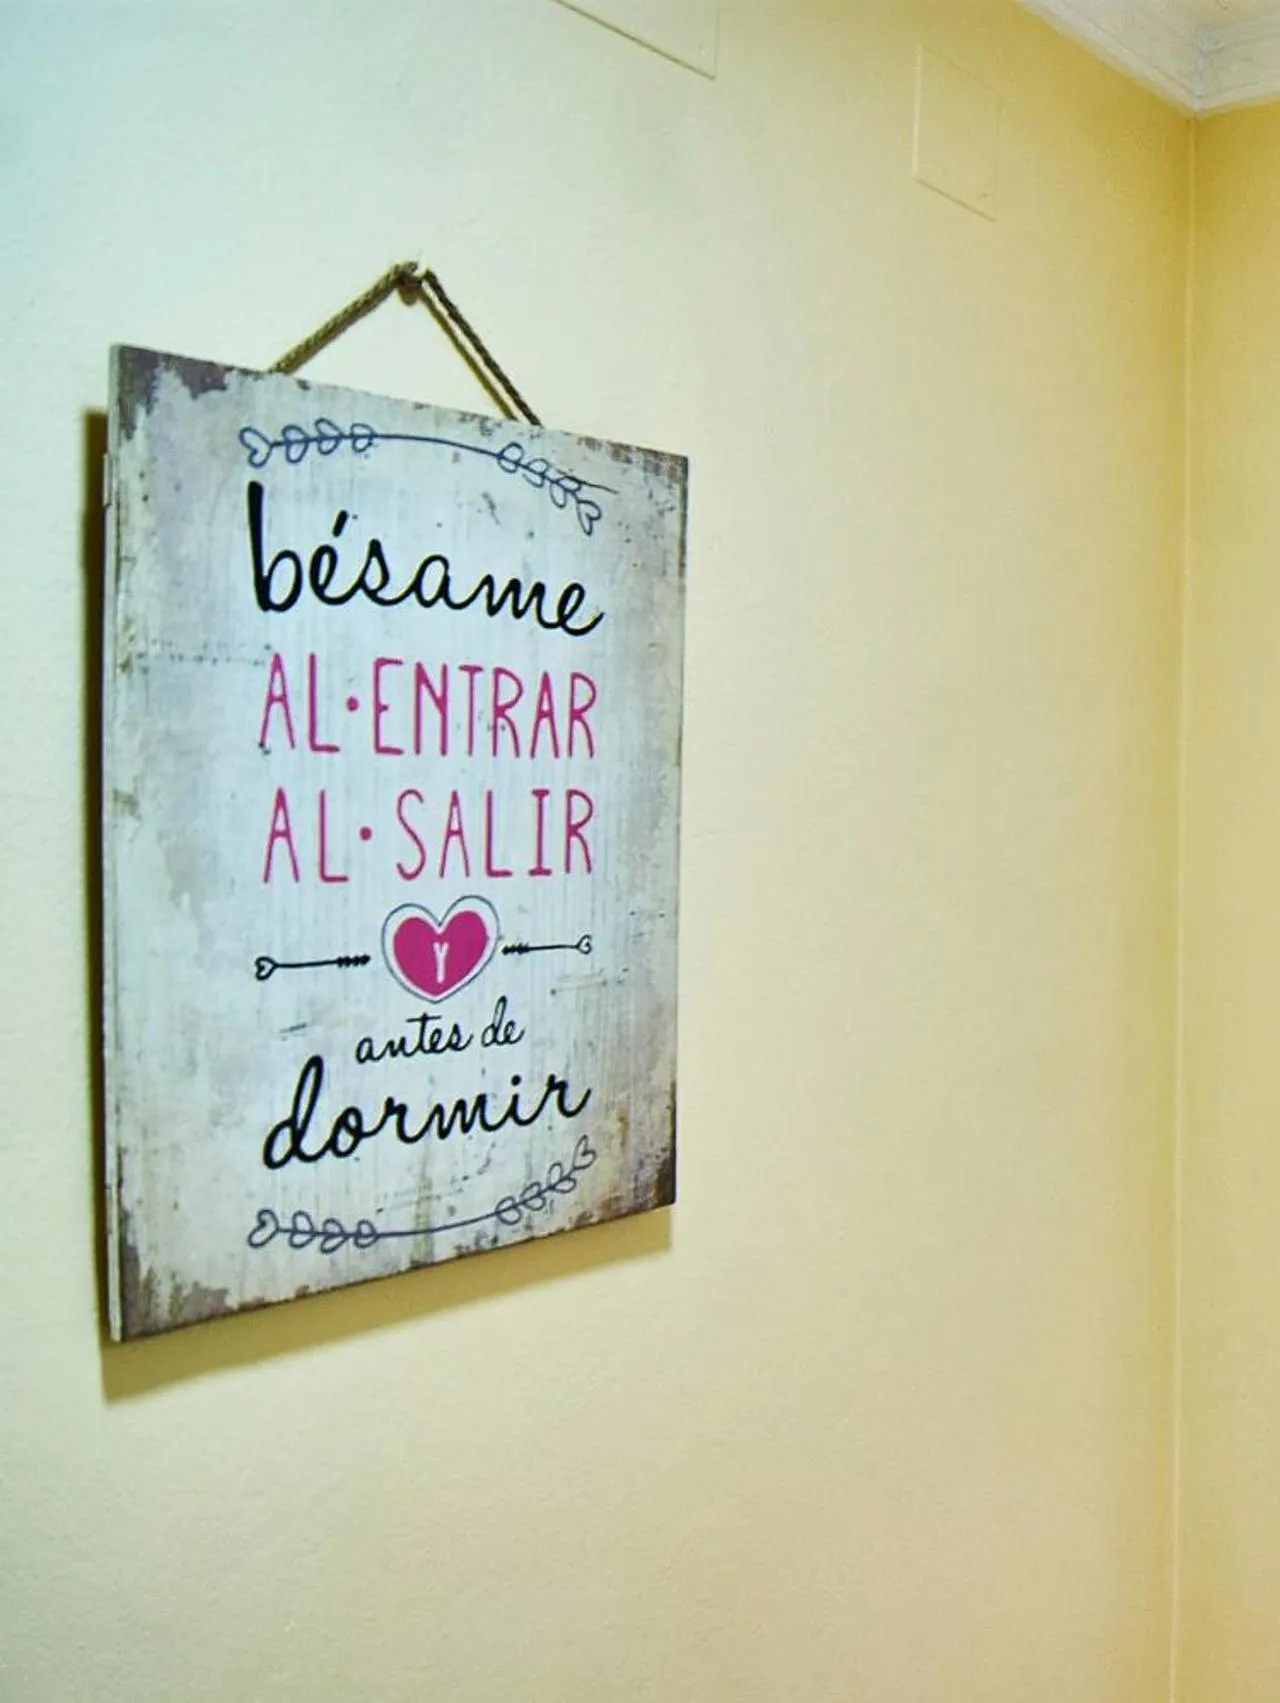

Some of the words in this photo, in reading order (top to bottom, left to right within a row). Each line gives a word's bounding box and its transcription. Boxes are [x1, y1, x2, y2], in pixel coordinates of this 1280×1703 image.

[247, 480, 605, 636] bésame
[396, 788, 595, 882] SALIR
[431, 940, 451, 984] Y
[355, 1012, 473, 1064] antes
[480, 995, 525, 1046] de
[263, 1055, 592, 1169] dormir
